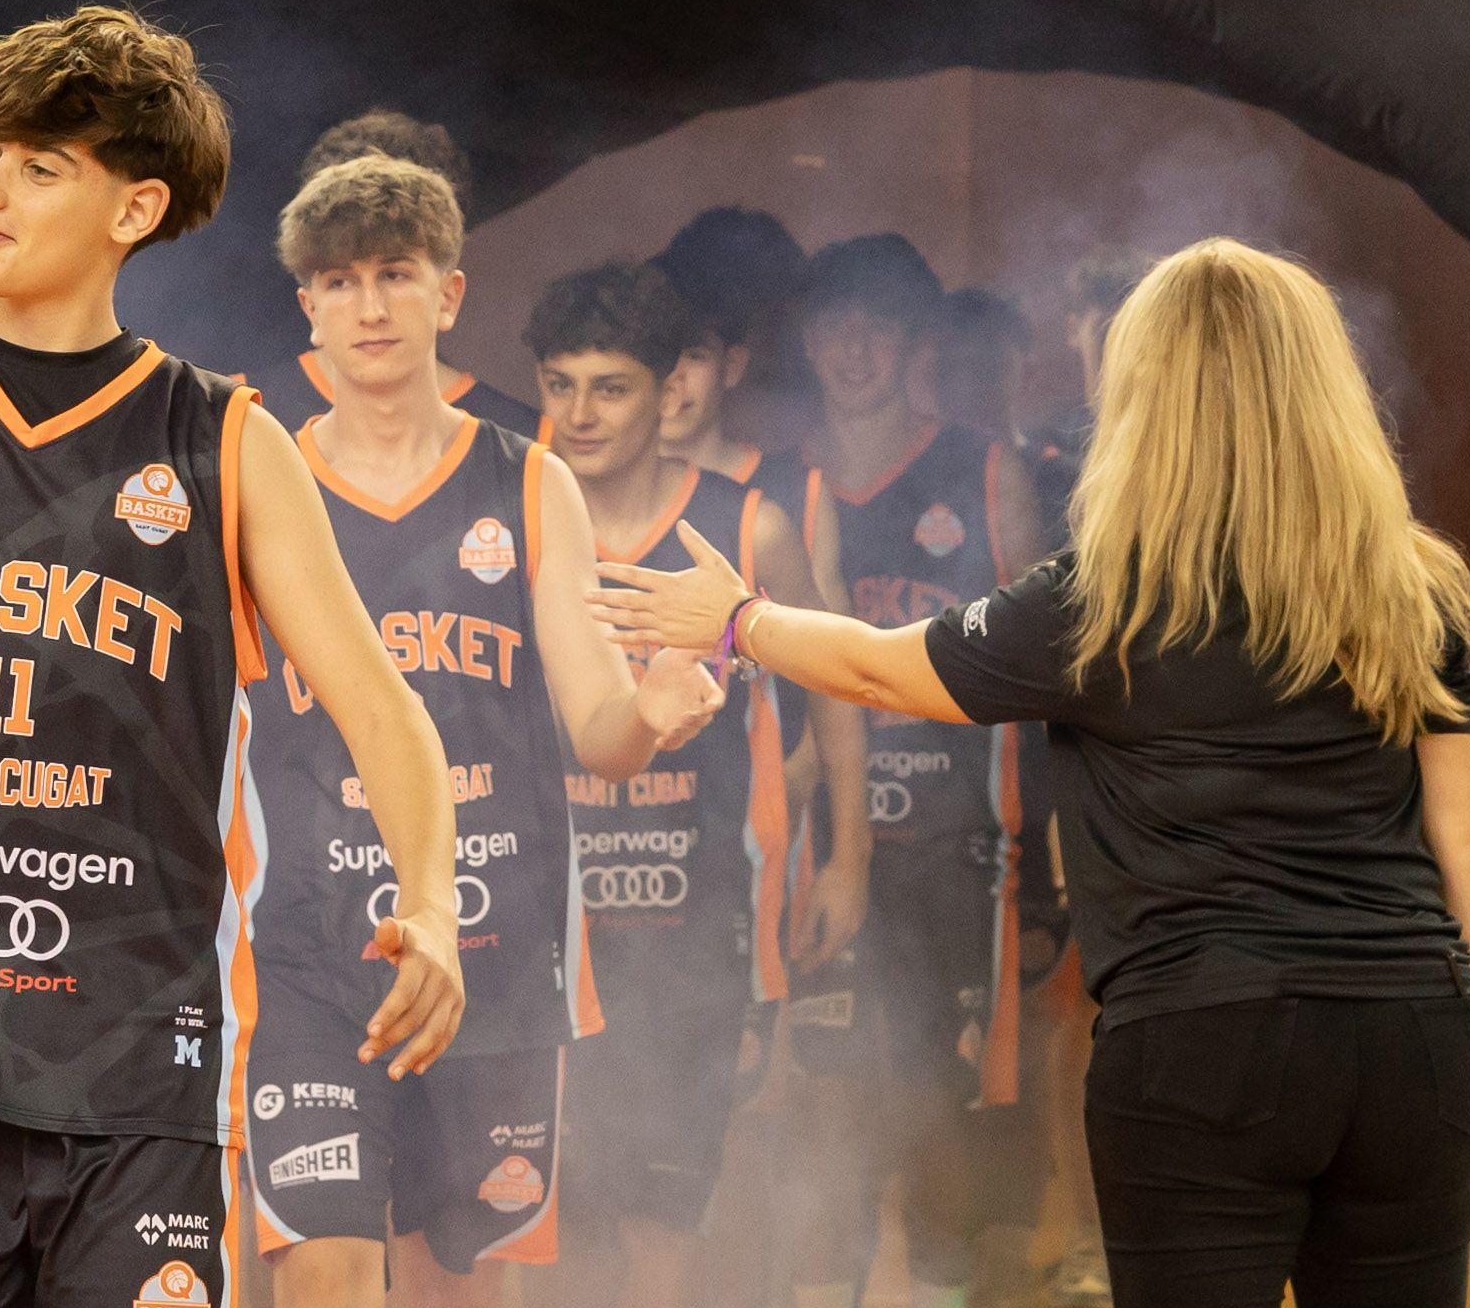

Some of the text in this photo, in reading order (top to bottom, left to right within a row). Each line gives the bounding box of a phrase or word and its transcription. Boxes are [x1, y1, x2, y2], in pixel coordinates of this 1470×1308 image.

[121, 499, 187, 524] BASKET
[184, 1006, 204, 1015] PLAY
[175, 1017, 186, 1026] TO
[174, 1035, 202, 1068] M
[292, 1082, 355, 1105] KERN
[168, 1213, 209, 1230] MARC
[167, 1233, 209, 1250] MART
